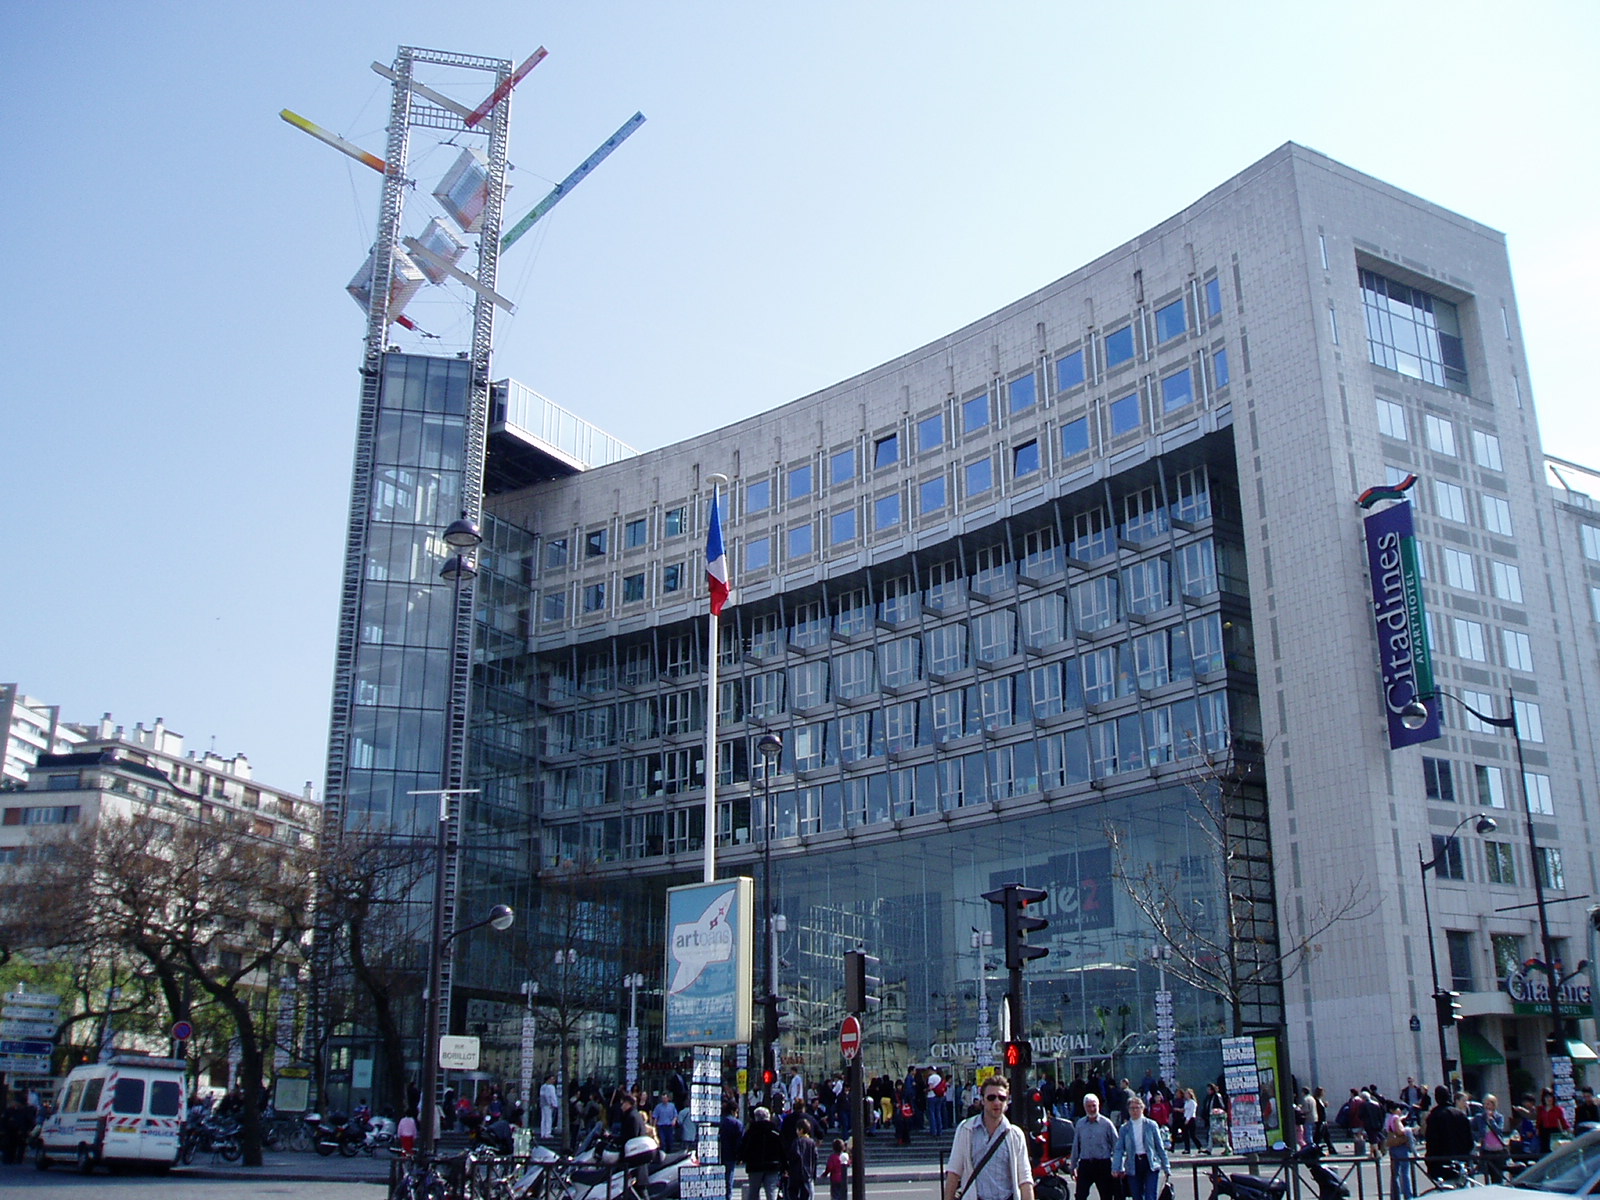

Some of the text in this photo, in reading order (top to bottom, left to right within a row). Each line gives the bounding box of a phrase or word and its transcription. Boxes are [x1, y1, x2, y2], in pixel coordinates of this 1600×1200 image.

[1375, 531, 1415, 715] Citadines
[1406, 570, 1425, 664] APART'HOTEL
[930, 1034, 1093, 1058] CENTR CMERCIAL
[147, 1129, 176, 1137] POLICE
